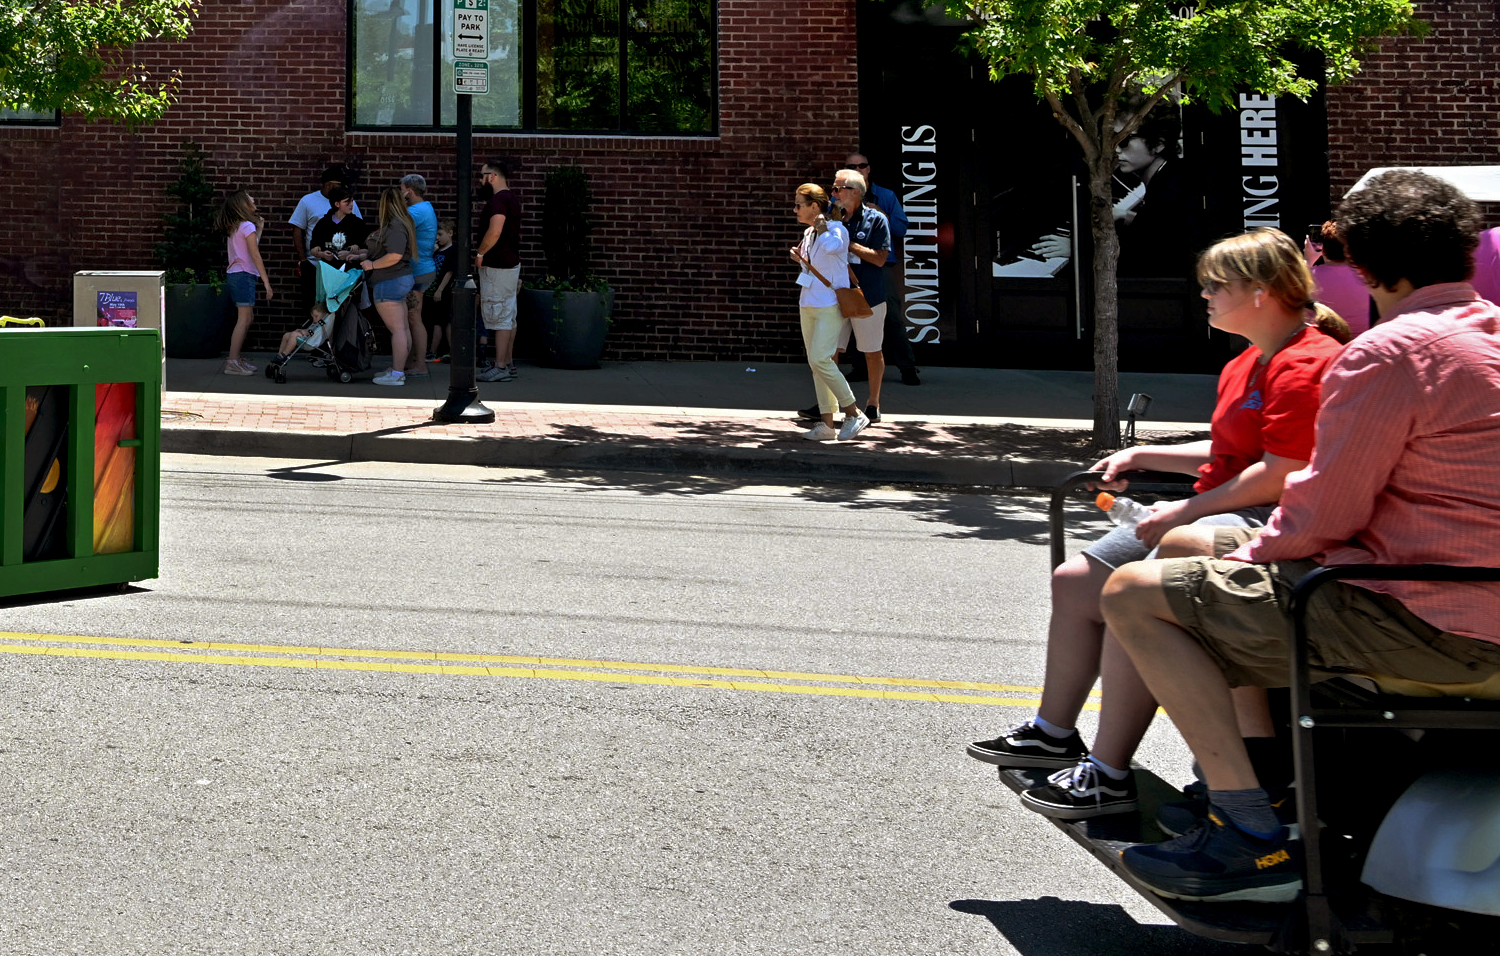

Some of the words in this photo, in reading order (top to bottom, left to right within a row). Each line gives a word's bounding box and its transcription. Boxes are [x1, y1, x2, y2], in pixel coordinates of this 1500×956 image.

[458, 13, 472, 21] PAY
[461, 23, 481, 31] PARK
[901, 124, 937, 153] IS
[1239, 92, 1279, 166] HERE
[902, 161, 941, 344] SOMETHING
[1254, 848, 1291, 870] HOKA
